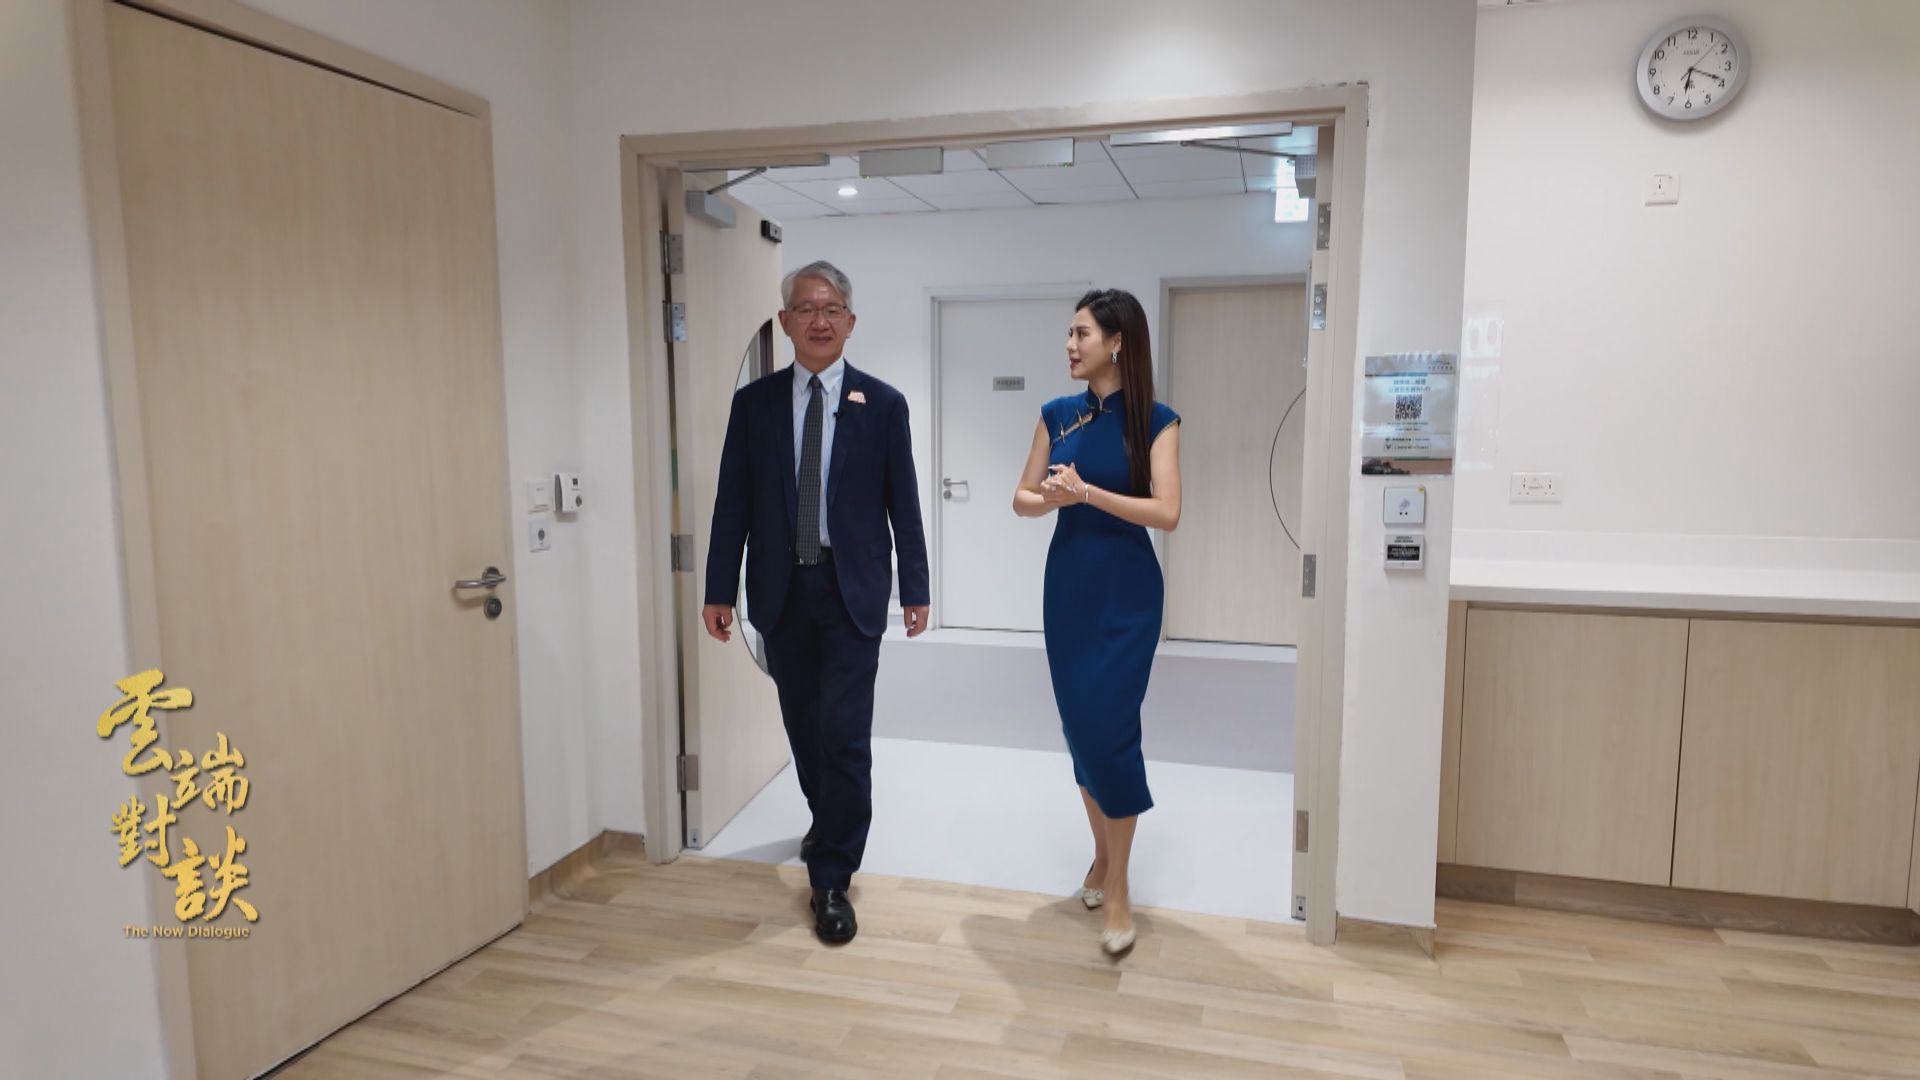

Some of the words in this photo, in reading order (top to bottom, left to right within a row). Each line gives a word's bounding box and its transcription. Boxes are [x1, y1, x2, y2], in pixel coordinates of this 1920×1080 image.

[1688, 28, 1698, 40] 12
[1667, 35, 1676, 47] 11
[1721, 43, 1729, 54] 2
[1654, 49, 1665, 61] 10
[1725, 60, 1732, 71] 3
[1649, 68, 1657, 77] 9
[1718, 79, 1725, 88] 4
[1653, 84, 1660, 95] 8
[1667, 96, 1674, 106] 7
[1684, 100, 1692, 109] 6
[1704, 94, 1711, 104] 5
